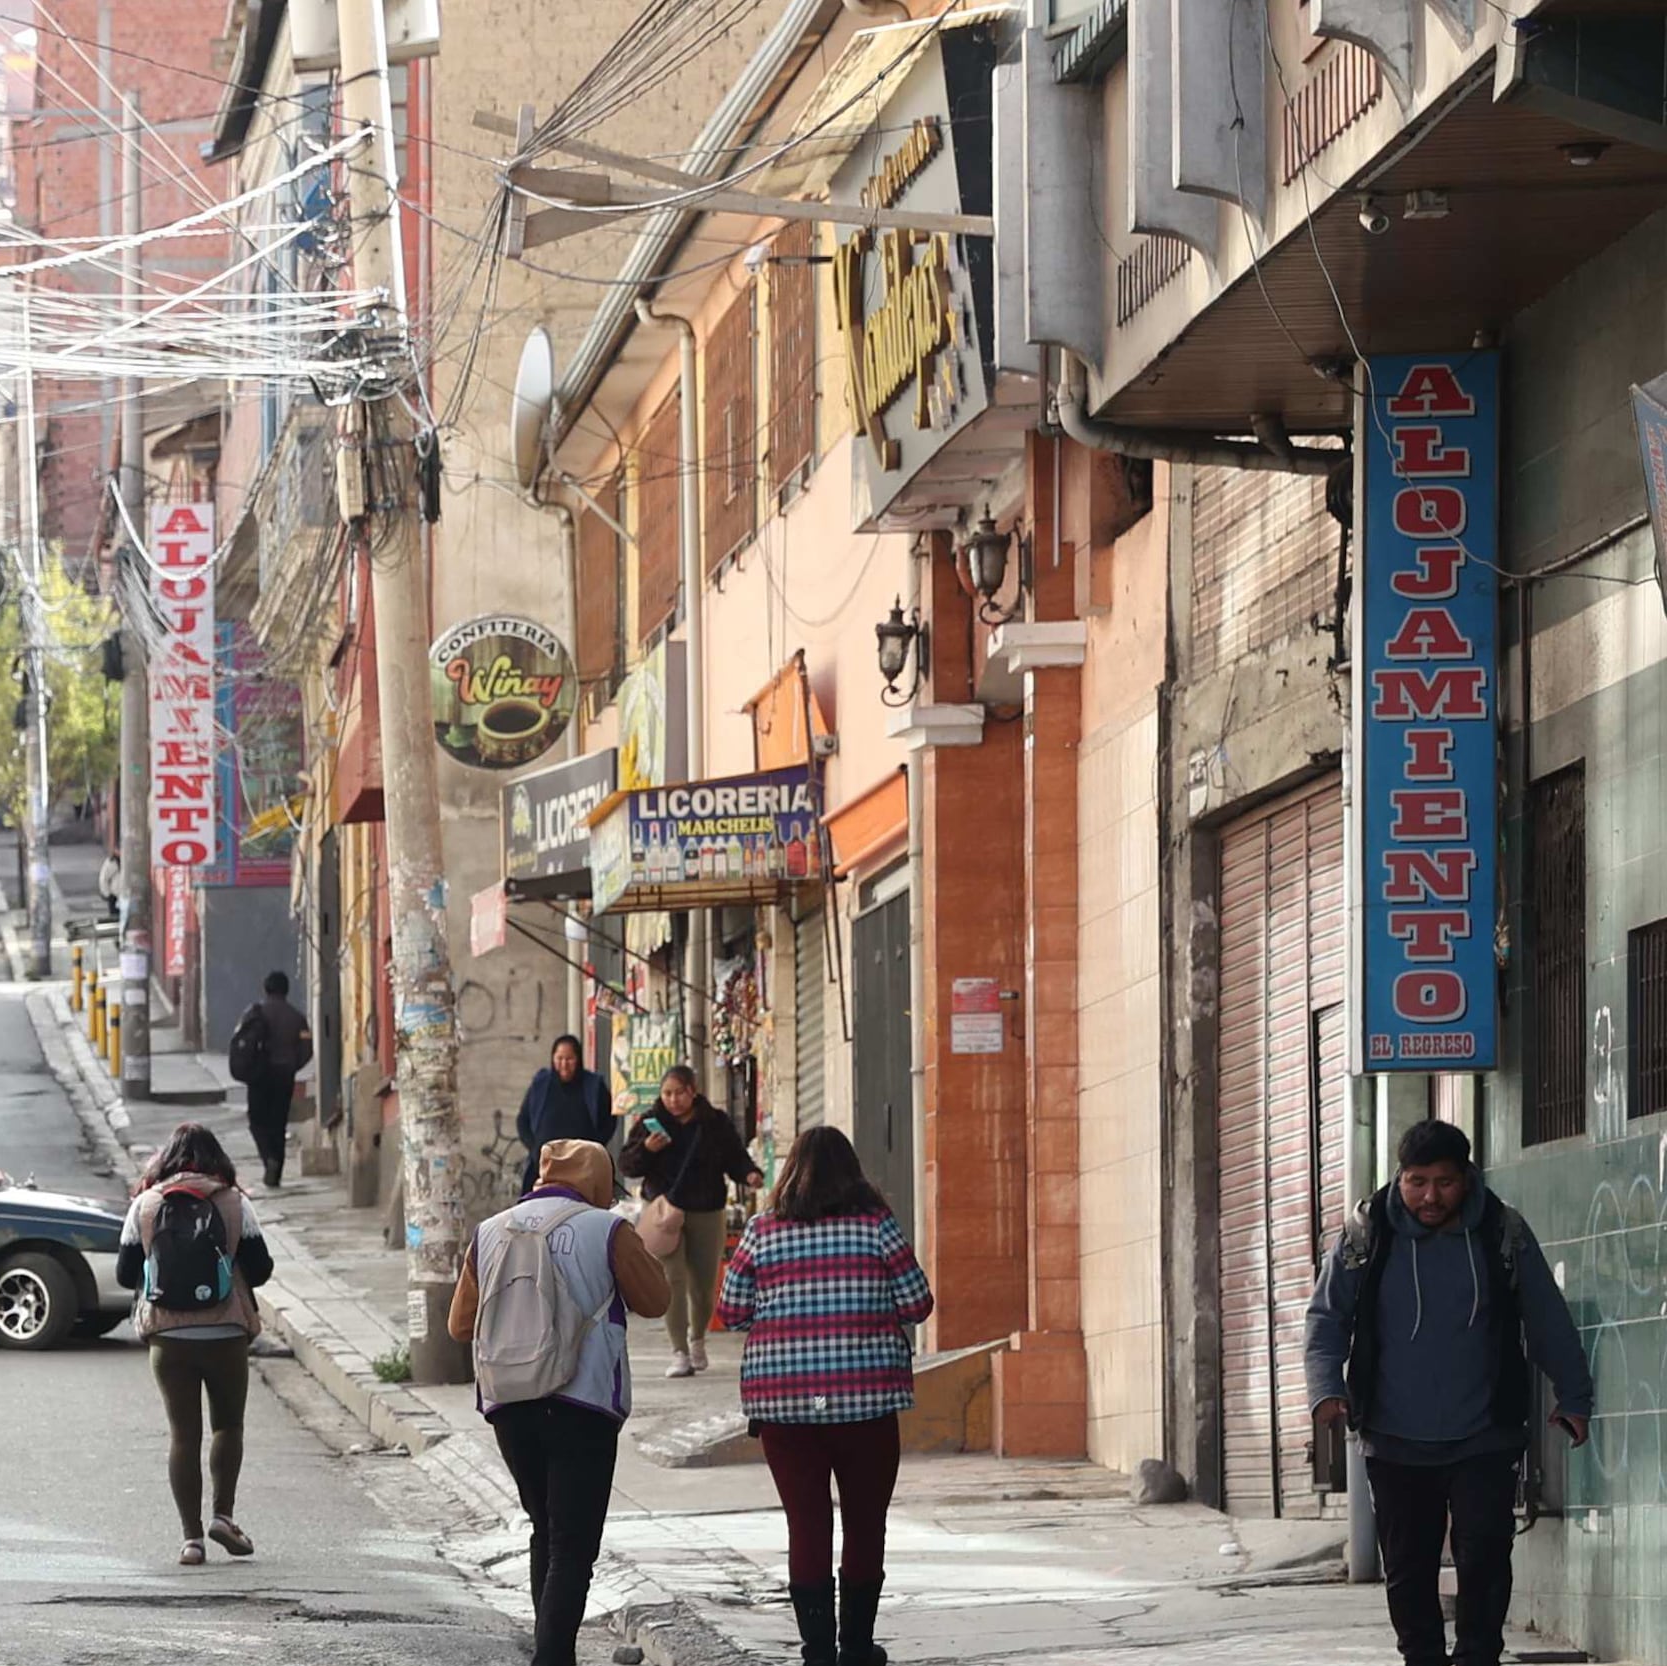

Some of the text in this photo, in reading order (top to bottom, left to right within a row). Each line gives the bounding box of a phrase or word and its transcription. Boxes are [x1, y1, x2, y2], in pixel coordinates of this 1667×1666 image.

[154, 507, 211, 866] ALOJAMIENTO
[445, 655, 565, 709] Wiñay
[1371, 364, 1488, 1024] ALOJAMIENTO
[638, 784, 814, 820] LICORERIA
[677, 816, 775, 837] MARCHELIS
[1368, 1032, 1476, 1061] EL REGRESO
[634, 1050, 673, 1080] PAN
